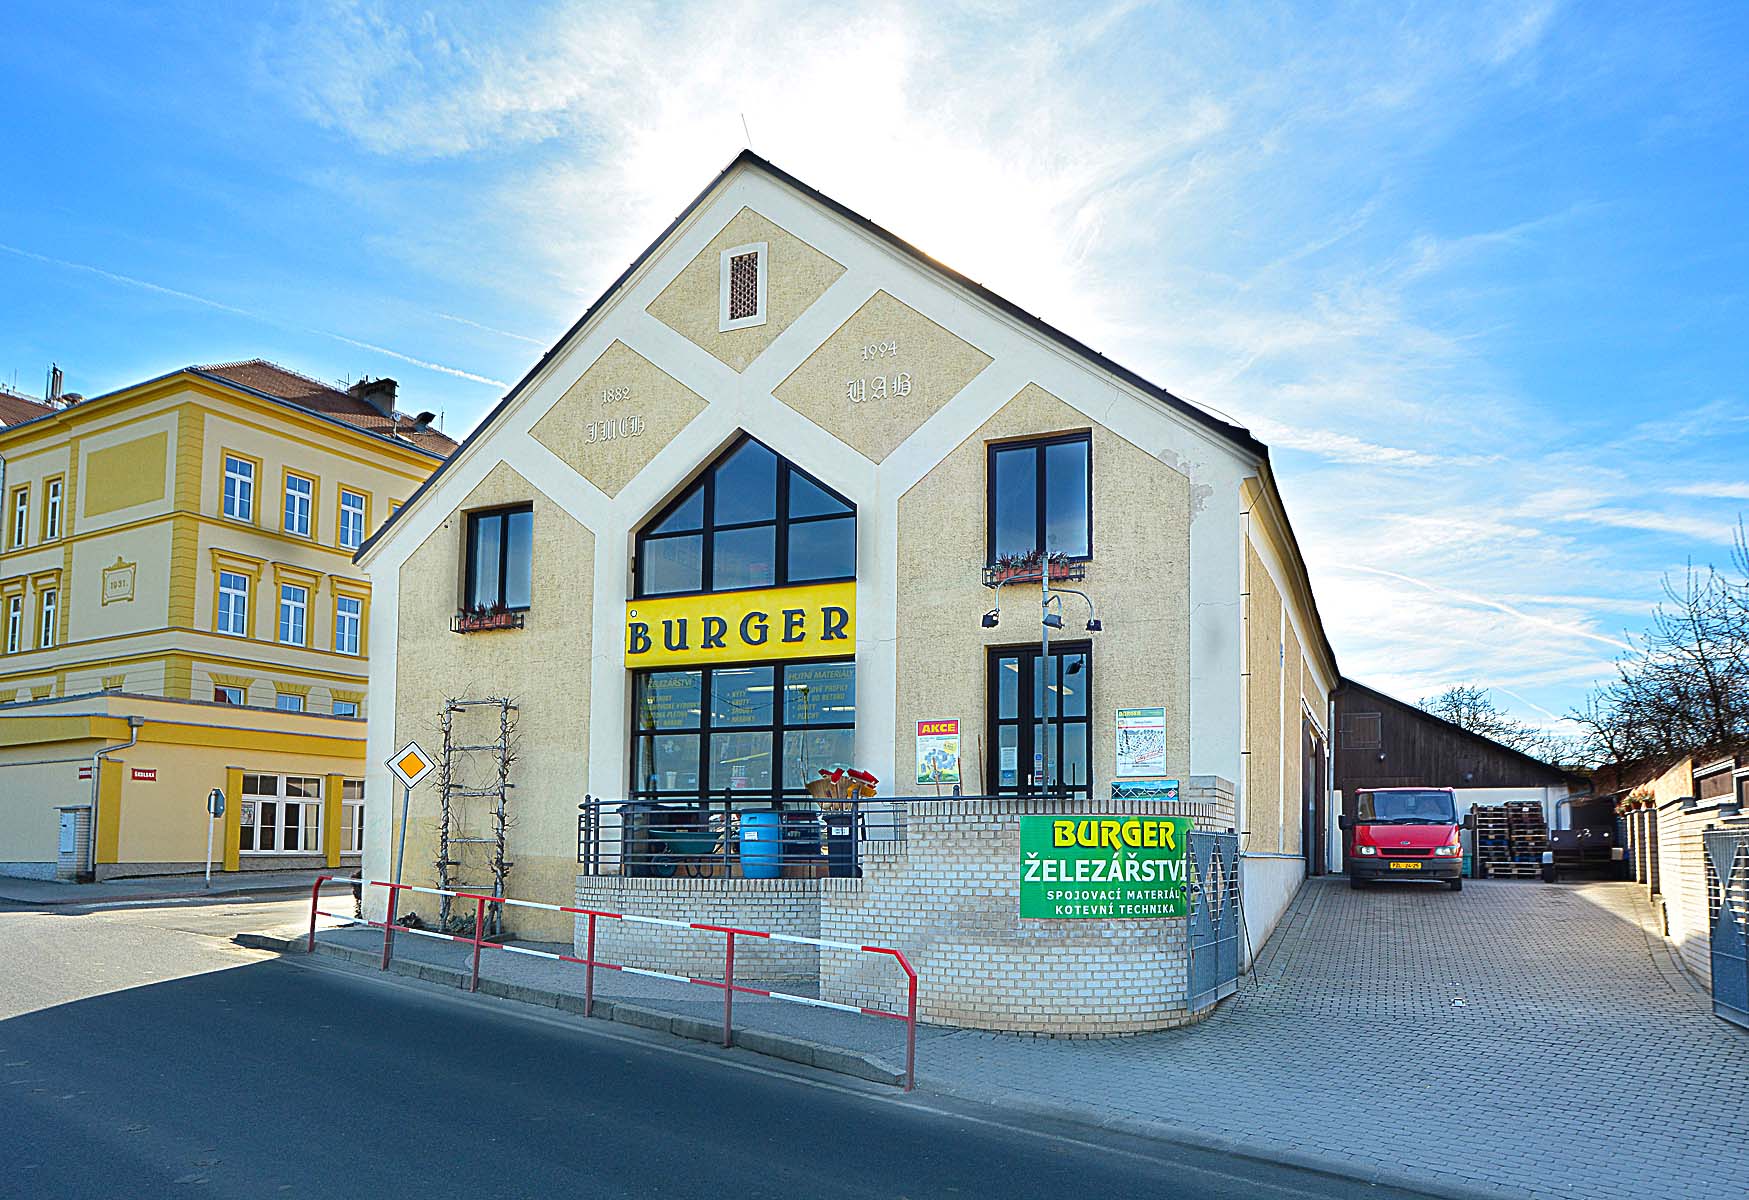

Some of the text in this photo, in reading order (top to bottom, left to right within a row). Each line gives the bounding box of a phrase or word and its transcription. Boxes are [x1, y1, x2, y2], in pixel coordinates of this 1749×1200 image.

[861, 341, 897, 361] 1994
[602, 386, 631, 406] 1882
[628, 606, 849, 655] BURGER
[921, 723, 956, 733] AKCE
[1053, 820, 1176, 850] BURGER
[1024, 852, 1187, 882] ŽELEZÁŘSTVÍ
[1047, 887, 1180, 900] SPOJOVACÍ MATERIÁL
[1056, 903, 1175, 915] KOTEVNÍ TECHNIKA
